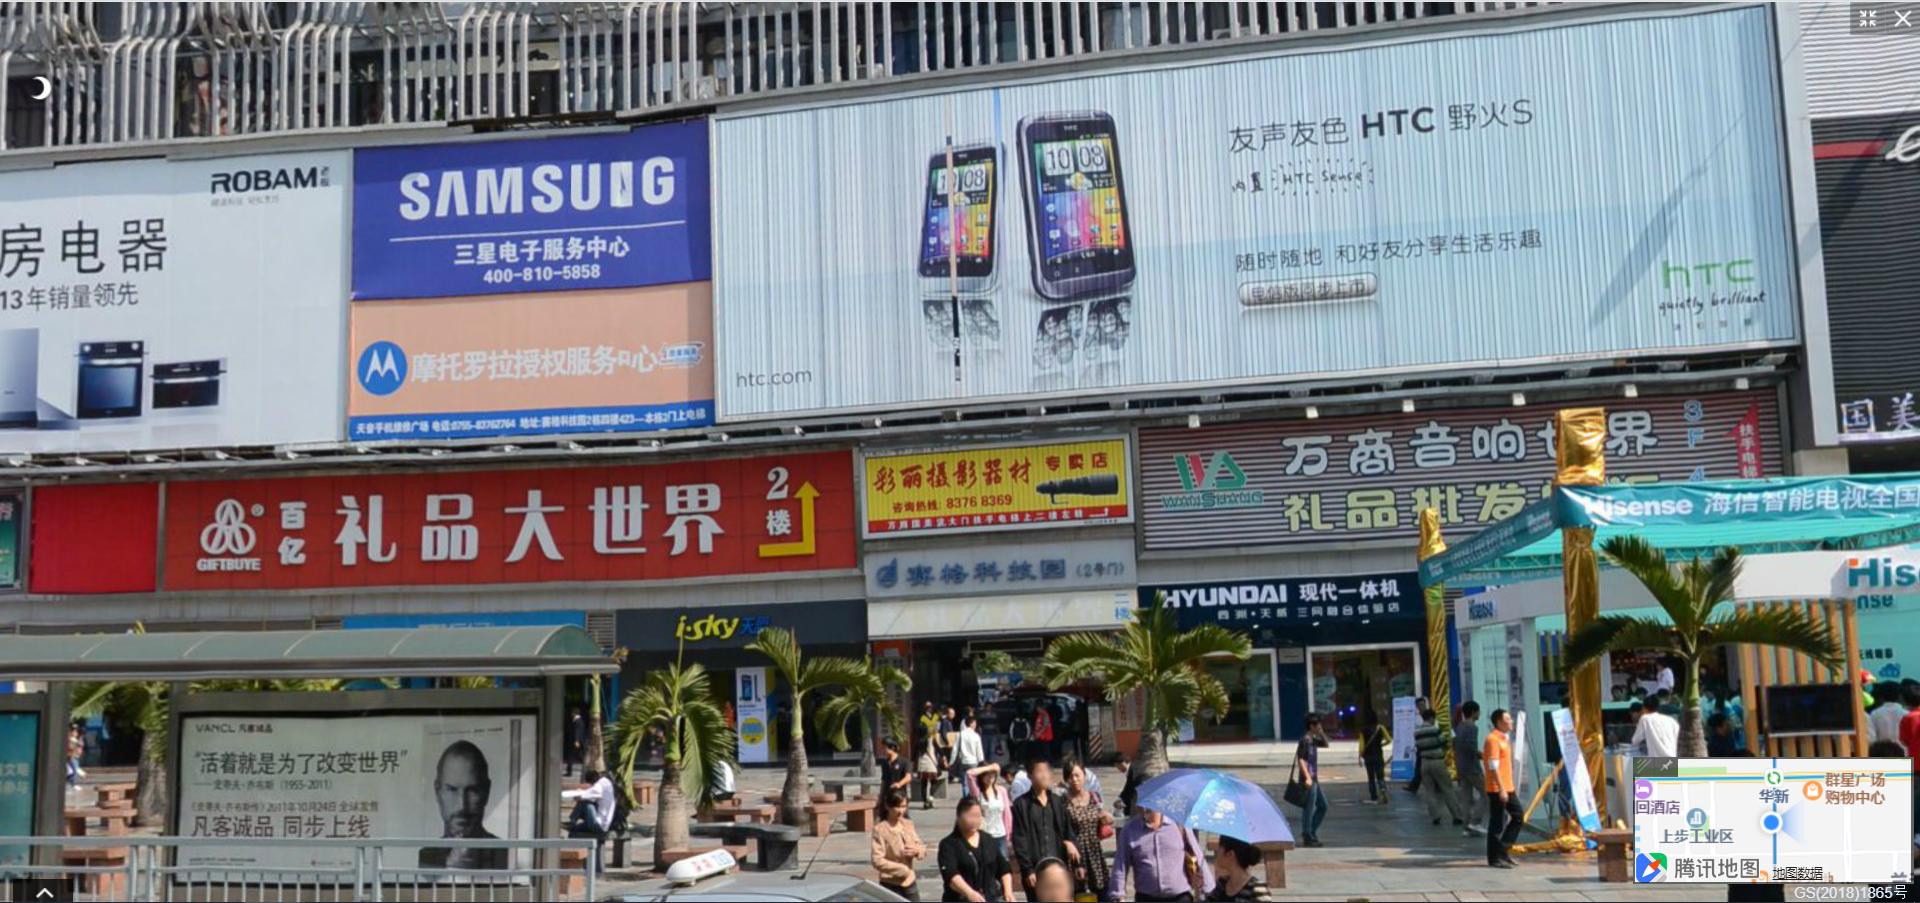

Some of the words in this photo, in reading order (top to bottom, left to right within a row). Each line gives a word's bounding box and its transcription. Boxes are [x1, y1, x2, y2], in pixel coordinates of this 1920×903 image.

[1228, 117, 1350, 154] 友声友色
[1361, 106, 1436, 139] HTC
[1447, 99, 1534, 132] 野火S
[1046, 148, 1071, 170] 10
[1079, 145, 1105, 167] 08
[211, 166, 318, 194] ROBAM
[963, 169, 985, 189] 08
[1282, 172, 1314, 185] HTC
[1321, 169, 1363, 184] Sense
[0, 218, 167, 278] 房电器
[453, 236, 631, 266] 三星电子服务中心
[1235, 245, 1324, 273] 随时随地
[1336, 228, 1543, 264] 和好友分享生活乐趣
[482, 264, 601, 284] 400-810-5858
[1661, 258, 1755, 290] htc
[0, 281, 139, 312] 13年销量领先
[1658, 296, 1704, 317] quietly
[1711, 289, 1767, 306] brilliant
[410, 345, 657, 384] 摩托罗拉授权服务中心
[735, 369, 812, 387] htc.com
[1841, 392, 1920, 434] 国美
[873, 456, 1032, 495] 彩丽摄影器材
[1045, 452, 1109, 471] 专卖店
[946, 495, 977, 509] 8376
[980, 494, 1012, 508] 8369
[1703, 485, 1920, 516] 海信智能电视全国
[278, 501, 308, 565] 百亿
[334, 482, 725, 567] 礼品大世界
[196, 557, 262, 572] GIFTBUYE
[1846, 555, 1920, 587] His
[1161, 583, 1289, 609] HYUNDAI
[1299, 578, 1401, 602] 现代一体机
[195, 724, 235, 734] VANCL
[191, 815, 274, 839] 凡客诚品
[282, 815, 371, 839] 同步上线
